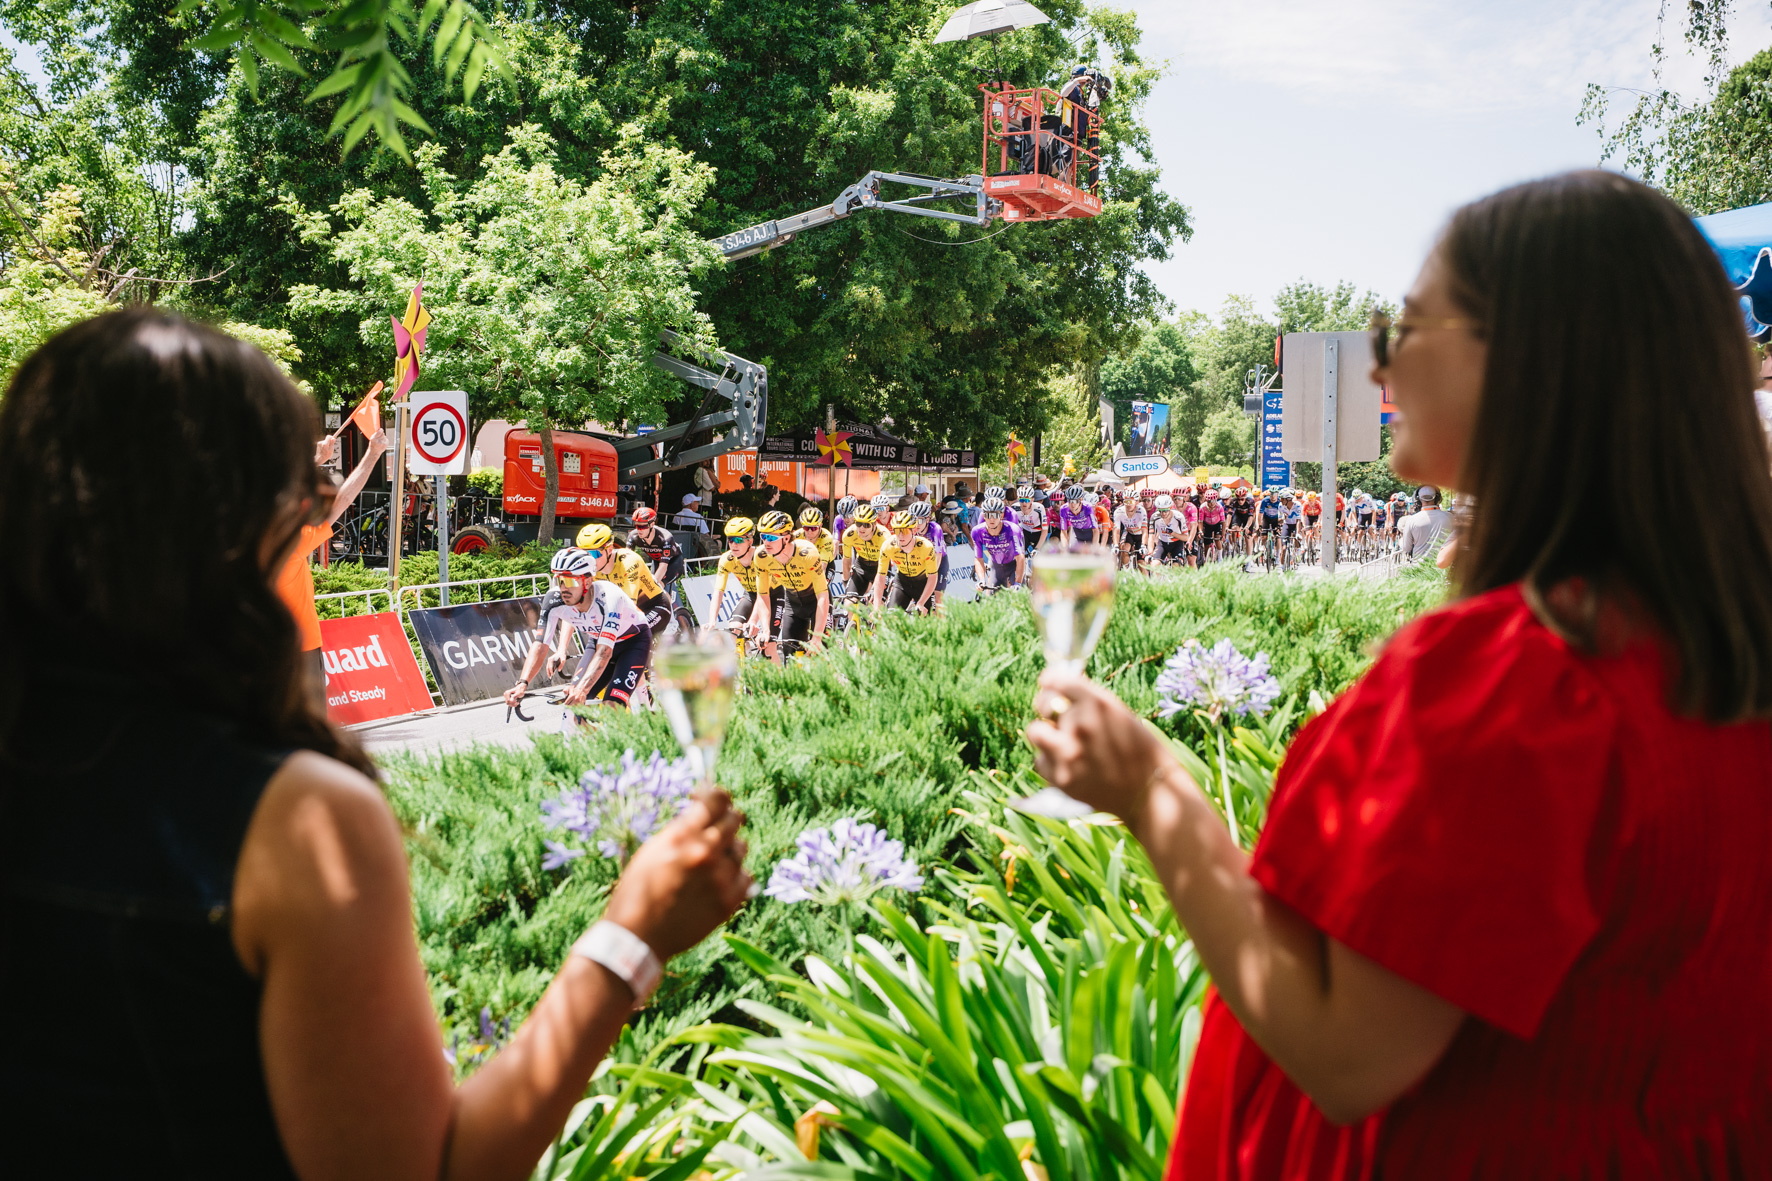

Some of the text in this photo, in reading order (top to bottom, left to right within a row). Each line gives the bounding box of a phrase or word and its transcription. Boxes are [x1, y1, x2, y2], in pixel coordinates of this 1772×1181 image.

[753, 226, 767, 242] AJ
[423, 419, 456, 446] 50
[856, 443, 881, 457] WITH
[883, 446, 896, 459] US
[726, 454, 747, 471] TOUR
[1121, 461, 1159, 472] Santos
[580, 496, 615, 508] SJ46 AJ
[322, 635, 389, 682] uard
[624, 670, 638, 690] G42
[328, 685, 387, 706] and Steady
